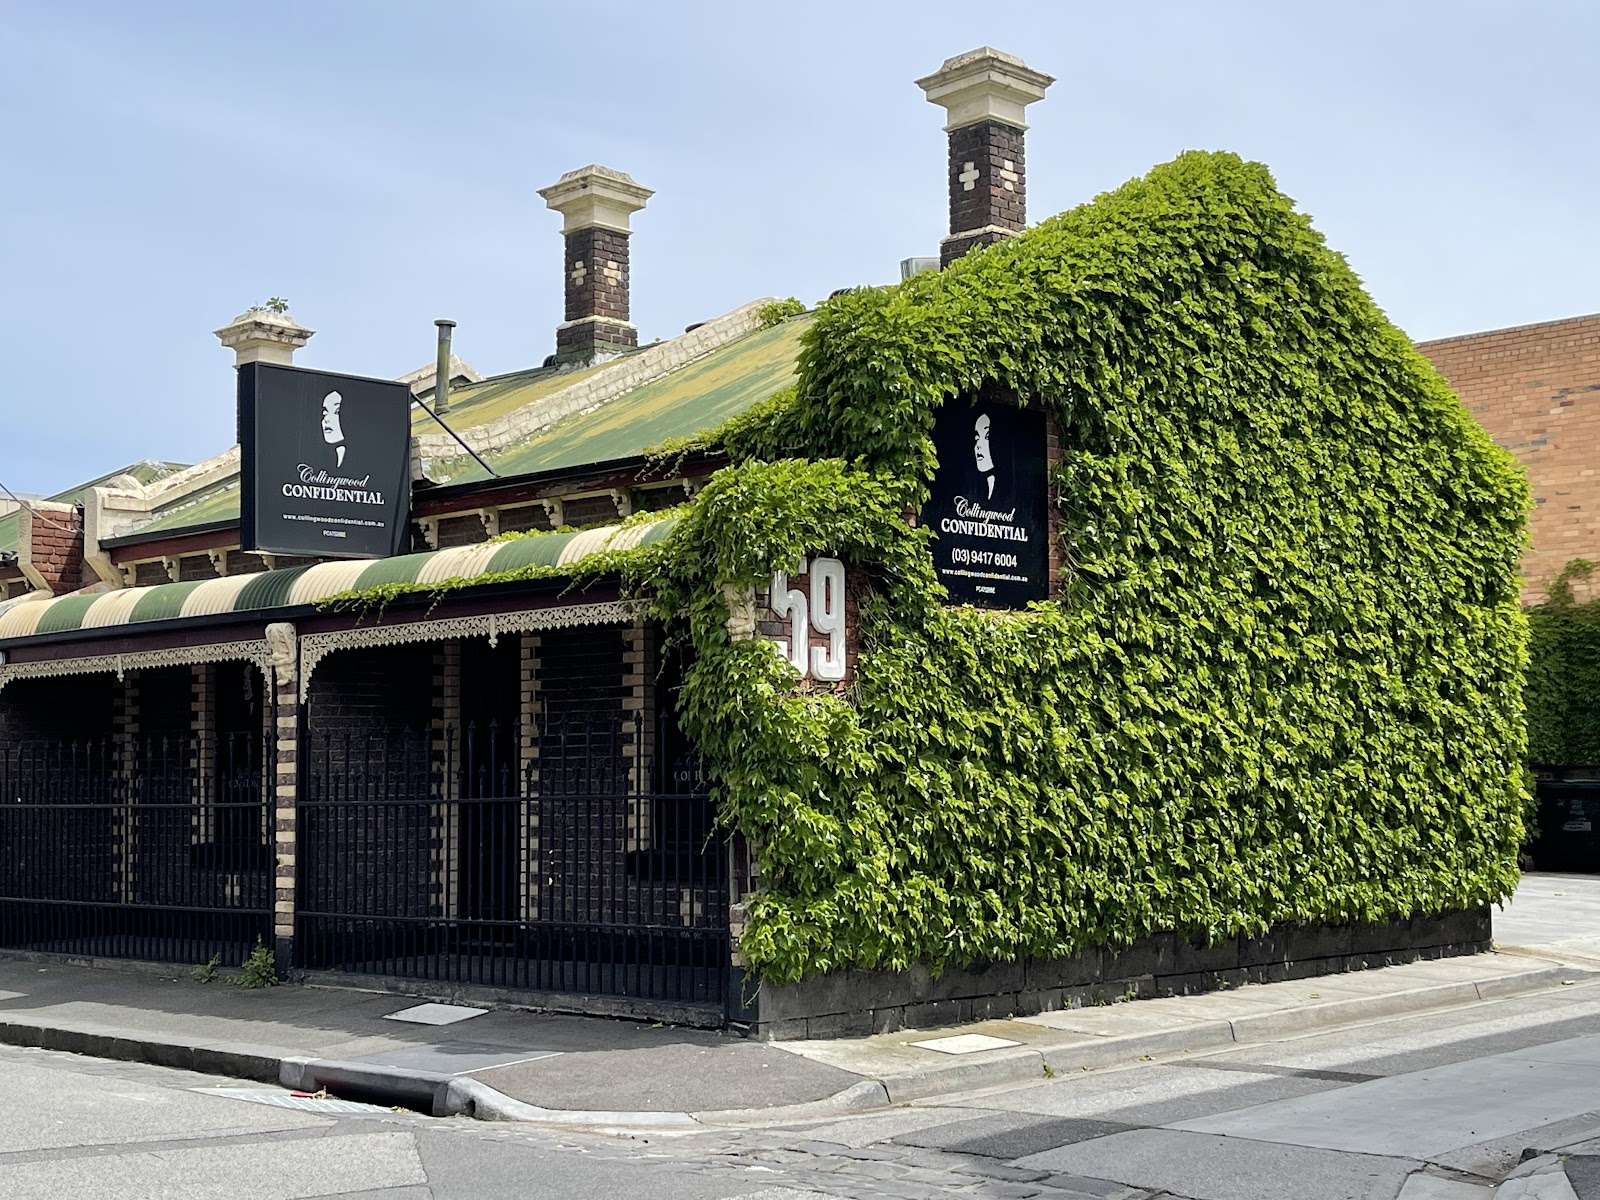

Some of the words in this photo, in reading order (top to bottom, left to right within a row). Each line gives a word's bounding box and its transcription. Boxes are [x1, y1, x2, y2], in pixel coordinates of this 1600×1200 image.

[297, 463, 370, 490] Collingwood
[282, 484, 385, 504] CONFIDENTIAL
[953, 495, 1016, 525] Collingwood
[941, 517, 1028, 542] CONFIDENTIAL
[952, 547, 970, 566] (03)
[970, 550, 993, 565] 9417
[994, 553, 1017, 568] 6004
[770, 556, 846, 682] 59
